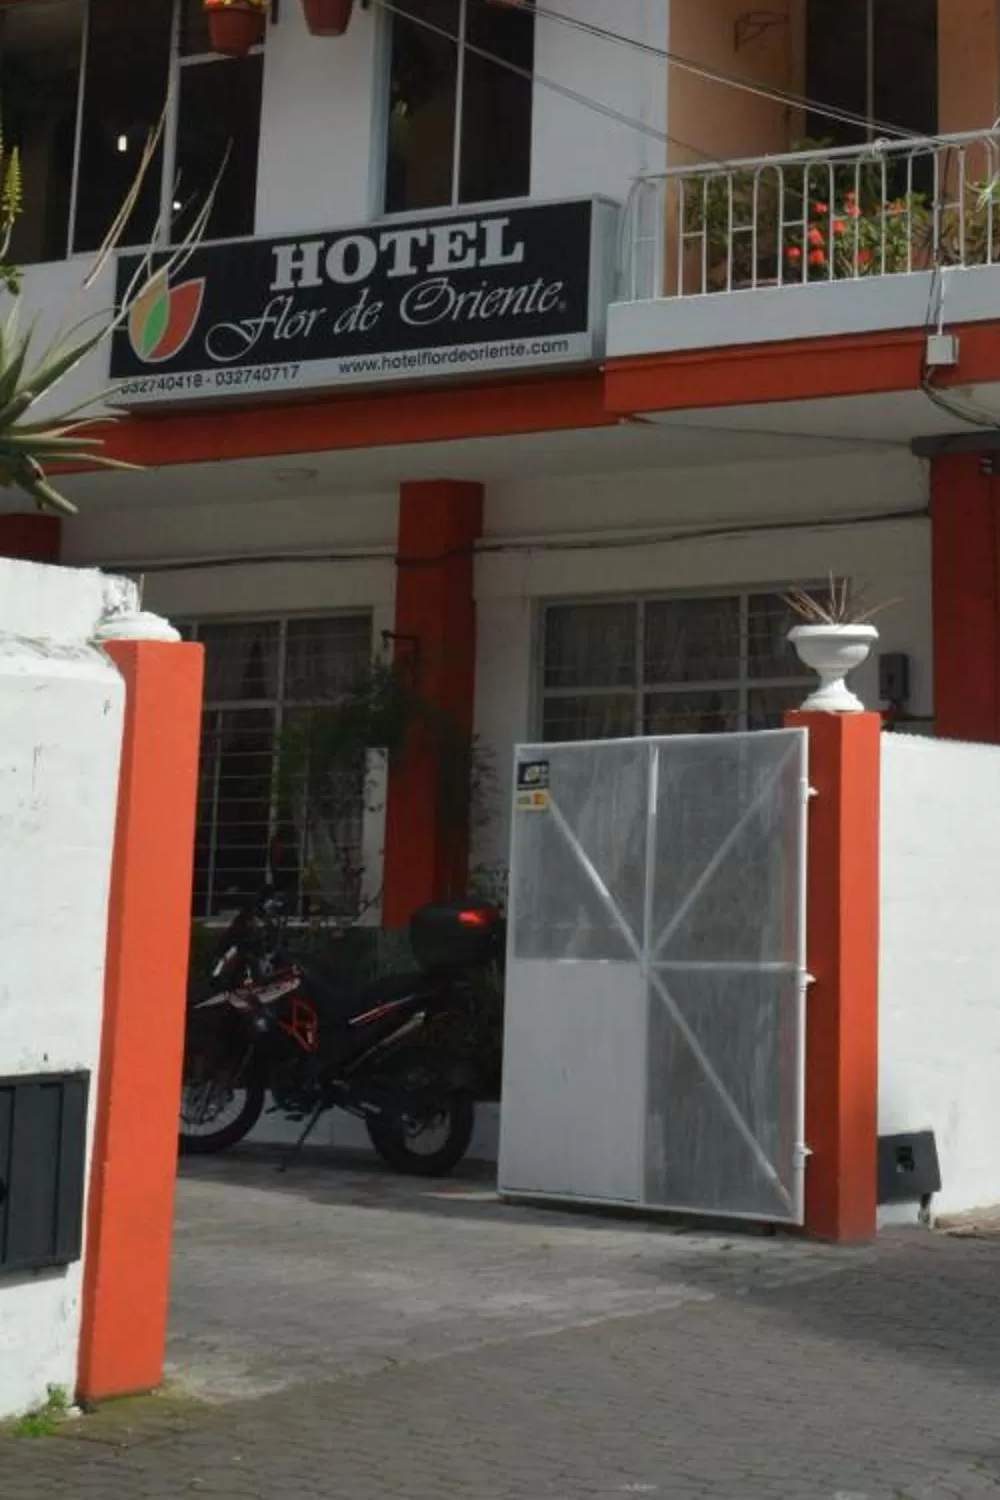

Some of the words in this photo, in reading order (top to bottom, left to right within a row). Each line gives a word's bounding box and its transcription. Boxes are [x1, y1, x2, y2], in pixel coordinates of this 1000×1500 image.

[269, 217, 525, 292] HOTEL
[205, 294, 327, 362] Flor
[333, 287, 384, 335] de
[400, 276, 565, 326] Oriente
[215, 364, 301, 386] 032740717
[338, 339, 569, 374] www.hotelflordeoriente.com
